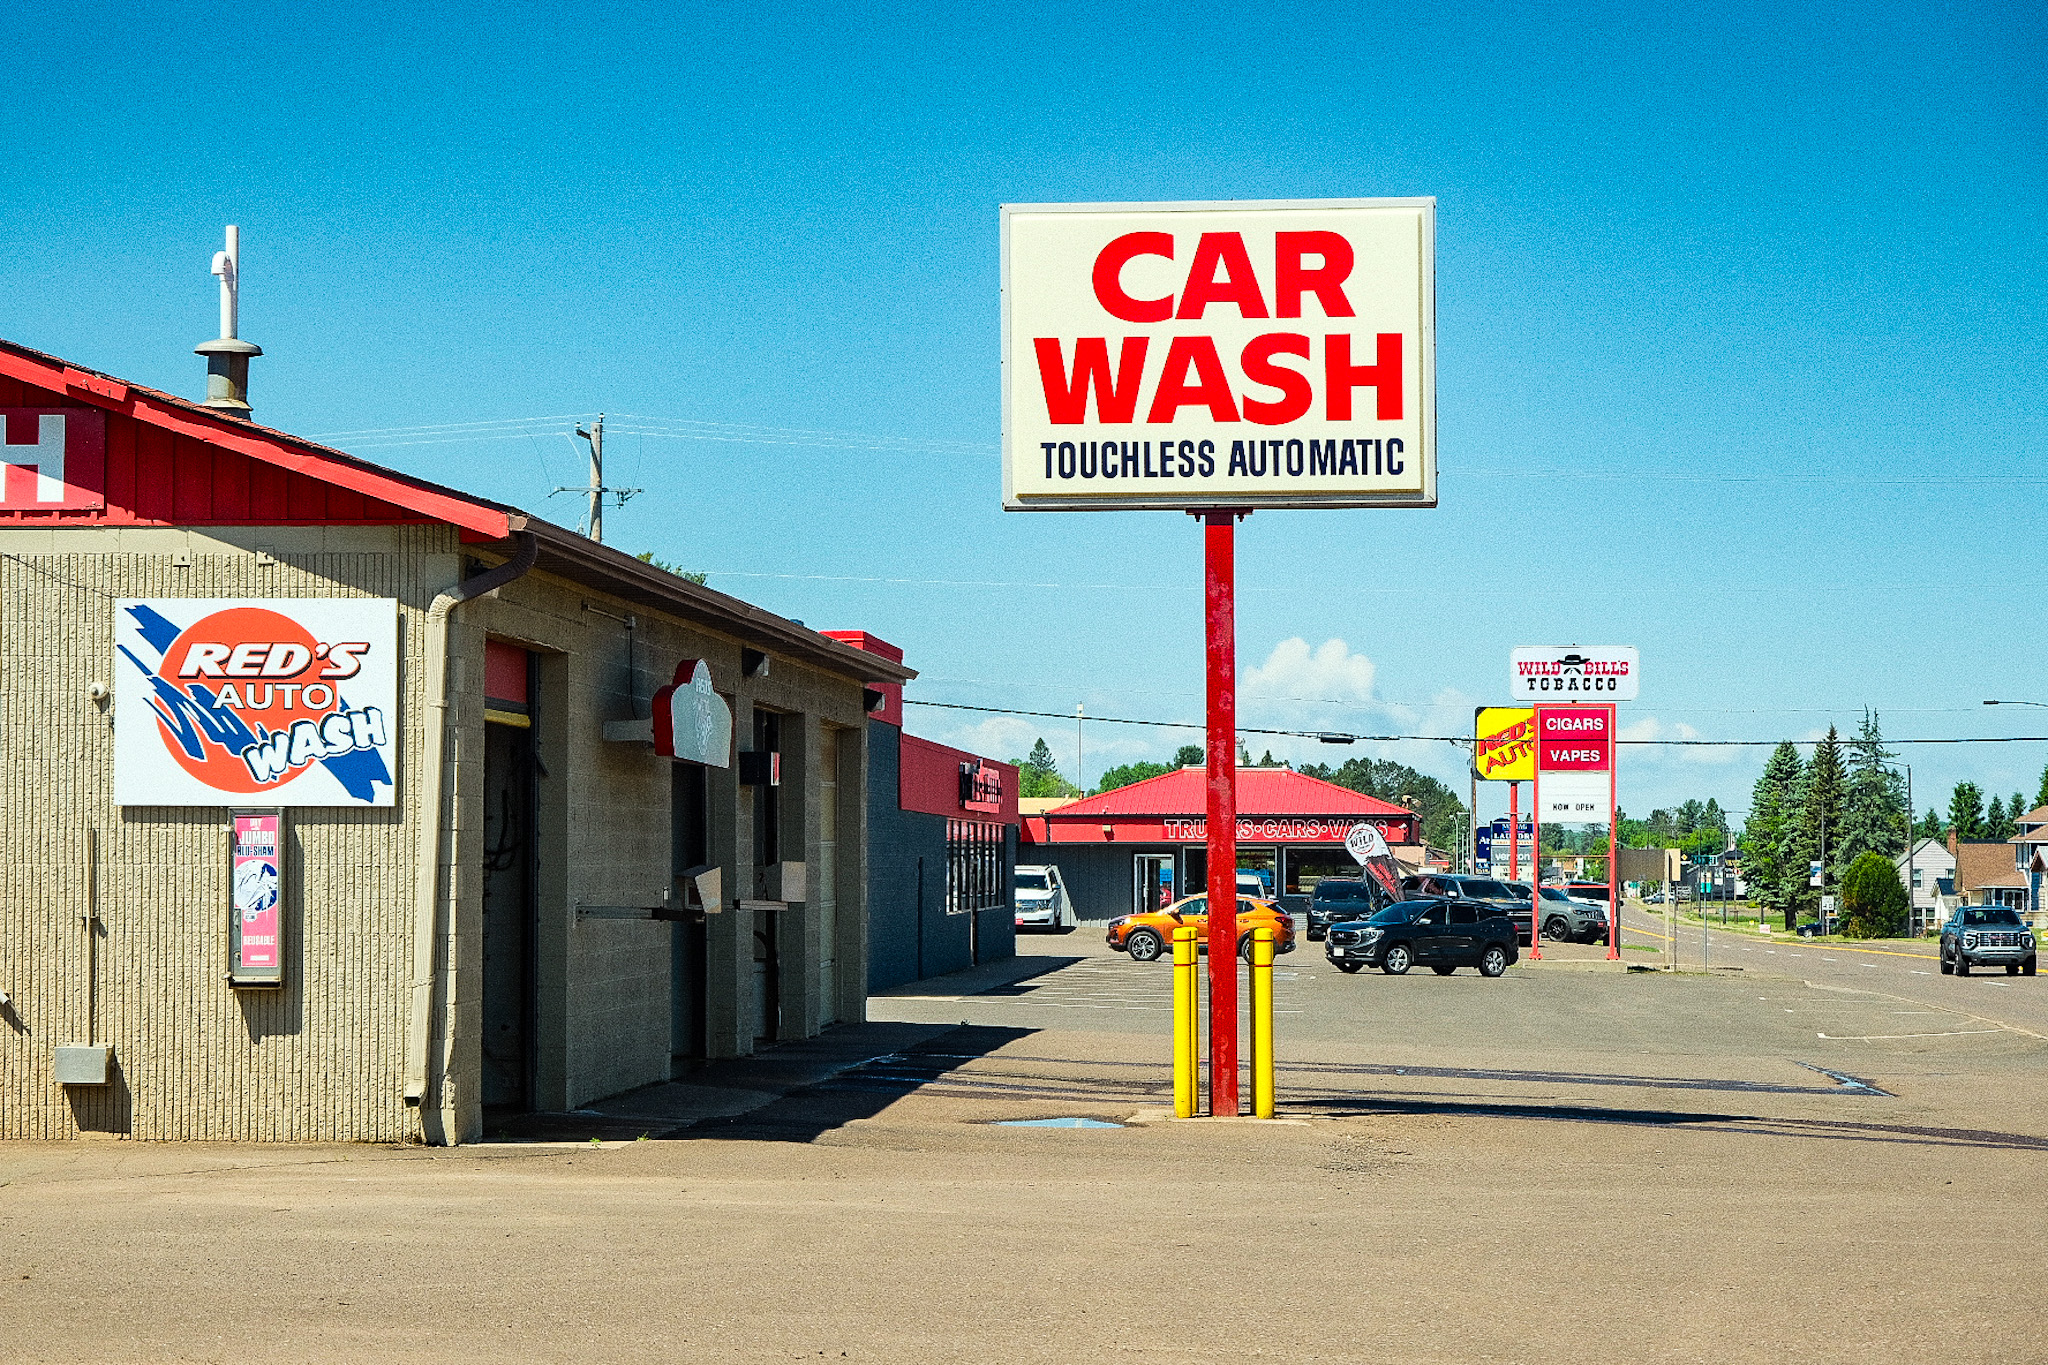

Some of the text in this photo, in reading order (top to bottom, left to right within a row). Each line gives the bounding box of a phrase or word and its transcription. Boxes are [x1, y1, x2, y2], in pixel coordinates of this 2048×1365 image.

[1092, 230, 1357, 323] CAR
[1033, 332, 1404, 426] WASH
[1041, 438, 1404, 479] TOUCHLESS AUTOMATIC
[178, 642, 370, 680] RED'S
[1518, 661, 1561, 676] WILD
[1527, 677, 1617, 691] TOBACCO
[212, 682, 335, 710] AUTO
[1546, 717, 1604, 731] CIGARS
[242, 707, 387, 783] WASH
[1550, 749, 1601, 762] VAPES
[1552, 803, 1595, 811] NOW OPEN
[239, 831, 275, 845] JUMBO
[1262, 819, 1321, 838] CARS
